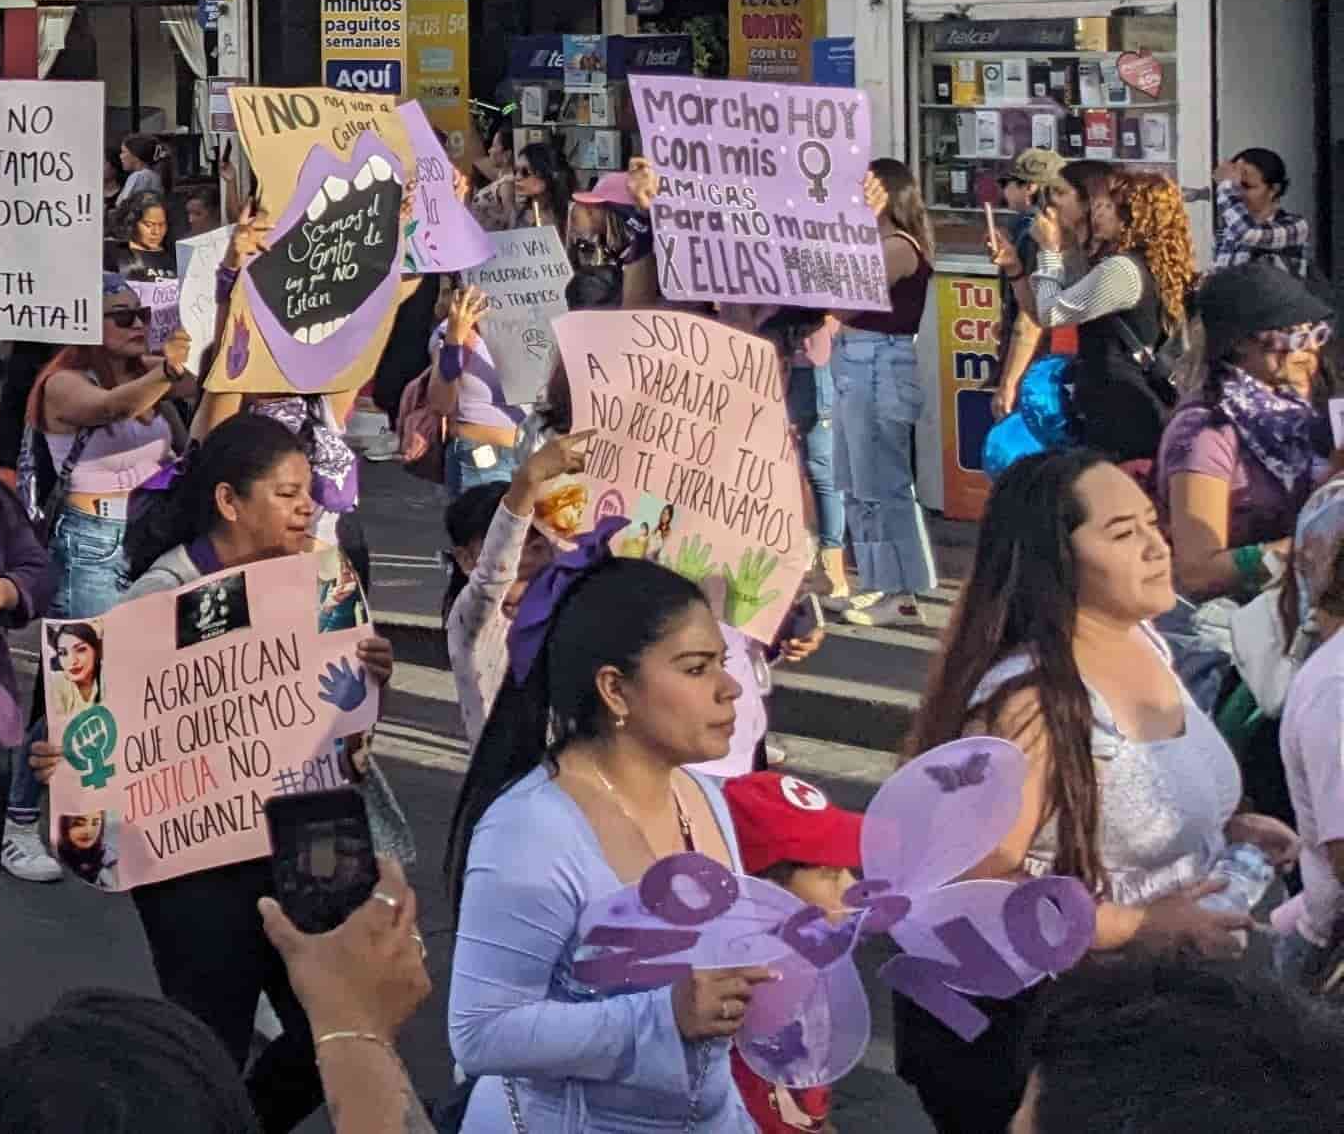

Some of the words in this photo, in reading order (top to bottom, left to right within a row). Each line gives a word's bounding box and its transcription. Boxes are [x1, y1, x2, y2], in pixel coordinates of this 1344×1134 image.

[325, 16, 401, 35] paguitos
[325, 35, 401, 48] semanales
[335, 63, 393, 92] AQUÍ
[7, 104, 53, 135] NO
[263, 92, 321, 134] NO
[351, 97, 374, 113] van
[379, 103, 392, 114] a
[642, 87, 779, 134] Marcho
[787, 96, 859, 140] HOY
[718, 138, 778, 177] mis
[288, 207, 363, 263] Somos
[731, 211, 770, 236] NO
[332, 263, 358, 283] NO
[657, 233, 684, 292] X
[688, 235, 781, 296] ELLAS
[951, 281, 993, 308] Tu
[632, 313, 710, 367] SOLO
[587, 353, 610, 384] A
[623, 352, 731, 425] TRABAJAR
[743, 401, 765, 443] Y
[590, 389, 624, 432] NO
[735, 447, 776, 500] TUS
[584, 434, 624, 484] HIJOS
[633, 450, 657, 492] TE
[665, 462, 794, 555] EXTRAÑAMOS
[144, 633, 301, 720] AGRADEZCAN
[124, 725, 166, 774] QUE
[176, 681, 316, 754] QUEREMOS
[124, 754, 219, 825] JUSTICIA
[228, 739, 272, 782] NO
[145, 790, 266, 859] VENGANZA
